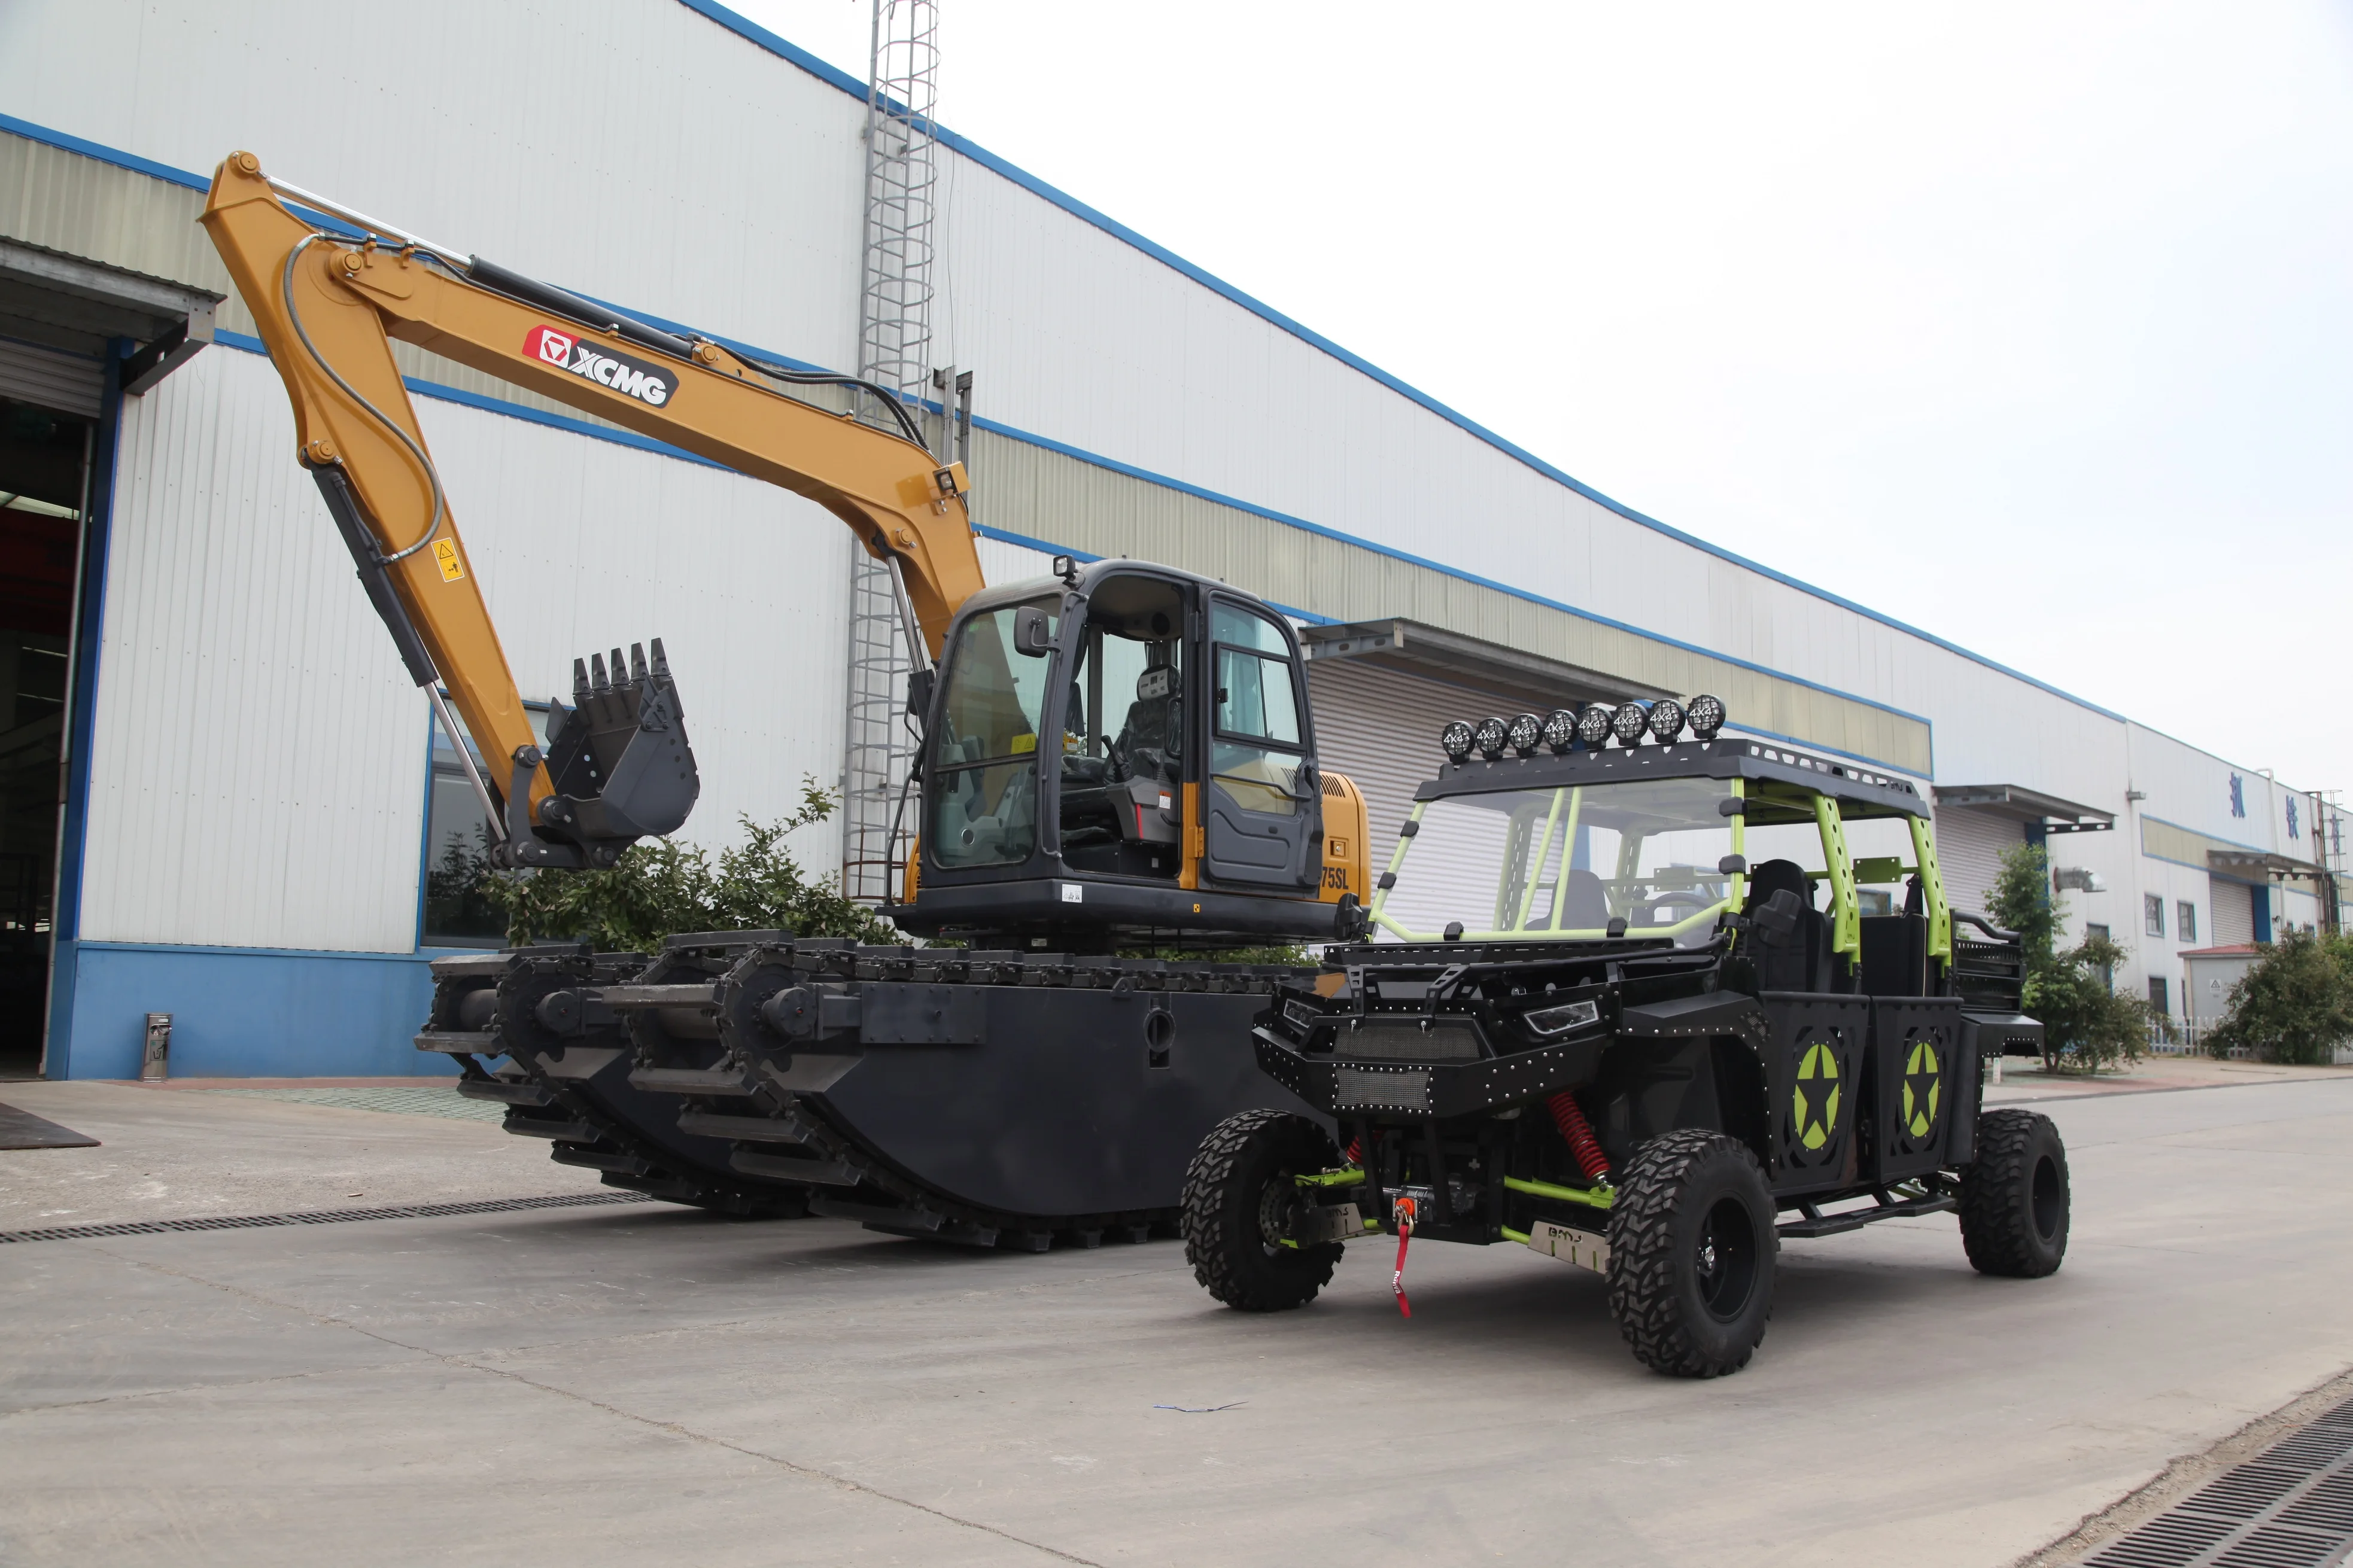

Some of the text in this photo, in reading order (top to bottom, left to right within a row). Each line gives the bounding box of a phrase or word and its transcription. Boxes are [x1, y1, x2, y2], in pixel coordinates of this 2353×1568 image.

[567, 346, 667, 406] XCMG
[1689, 708, 1712, 717] 4X4
[1613, 717, 1636, 726] 4X4
[1650, 713, 1673, 722] 4X4
[1545, 723, 1565, 733] 4X4
[1579, 720, 1601, 729] 4X4
[1477, 730, 1497, 740] 4X4
[1510, 727, 1531, 736] 4X4
[1443, 735, 1464, 744] 4X4
[1322, 866, 1349, 890] 75SL
[1392, 1270, 1401, 1294] Runva
